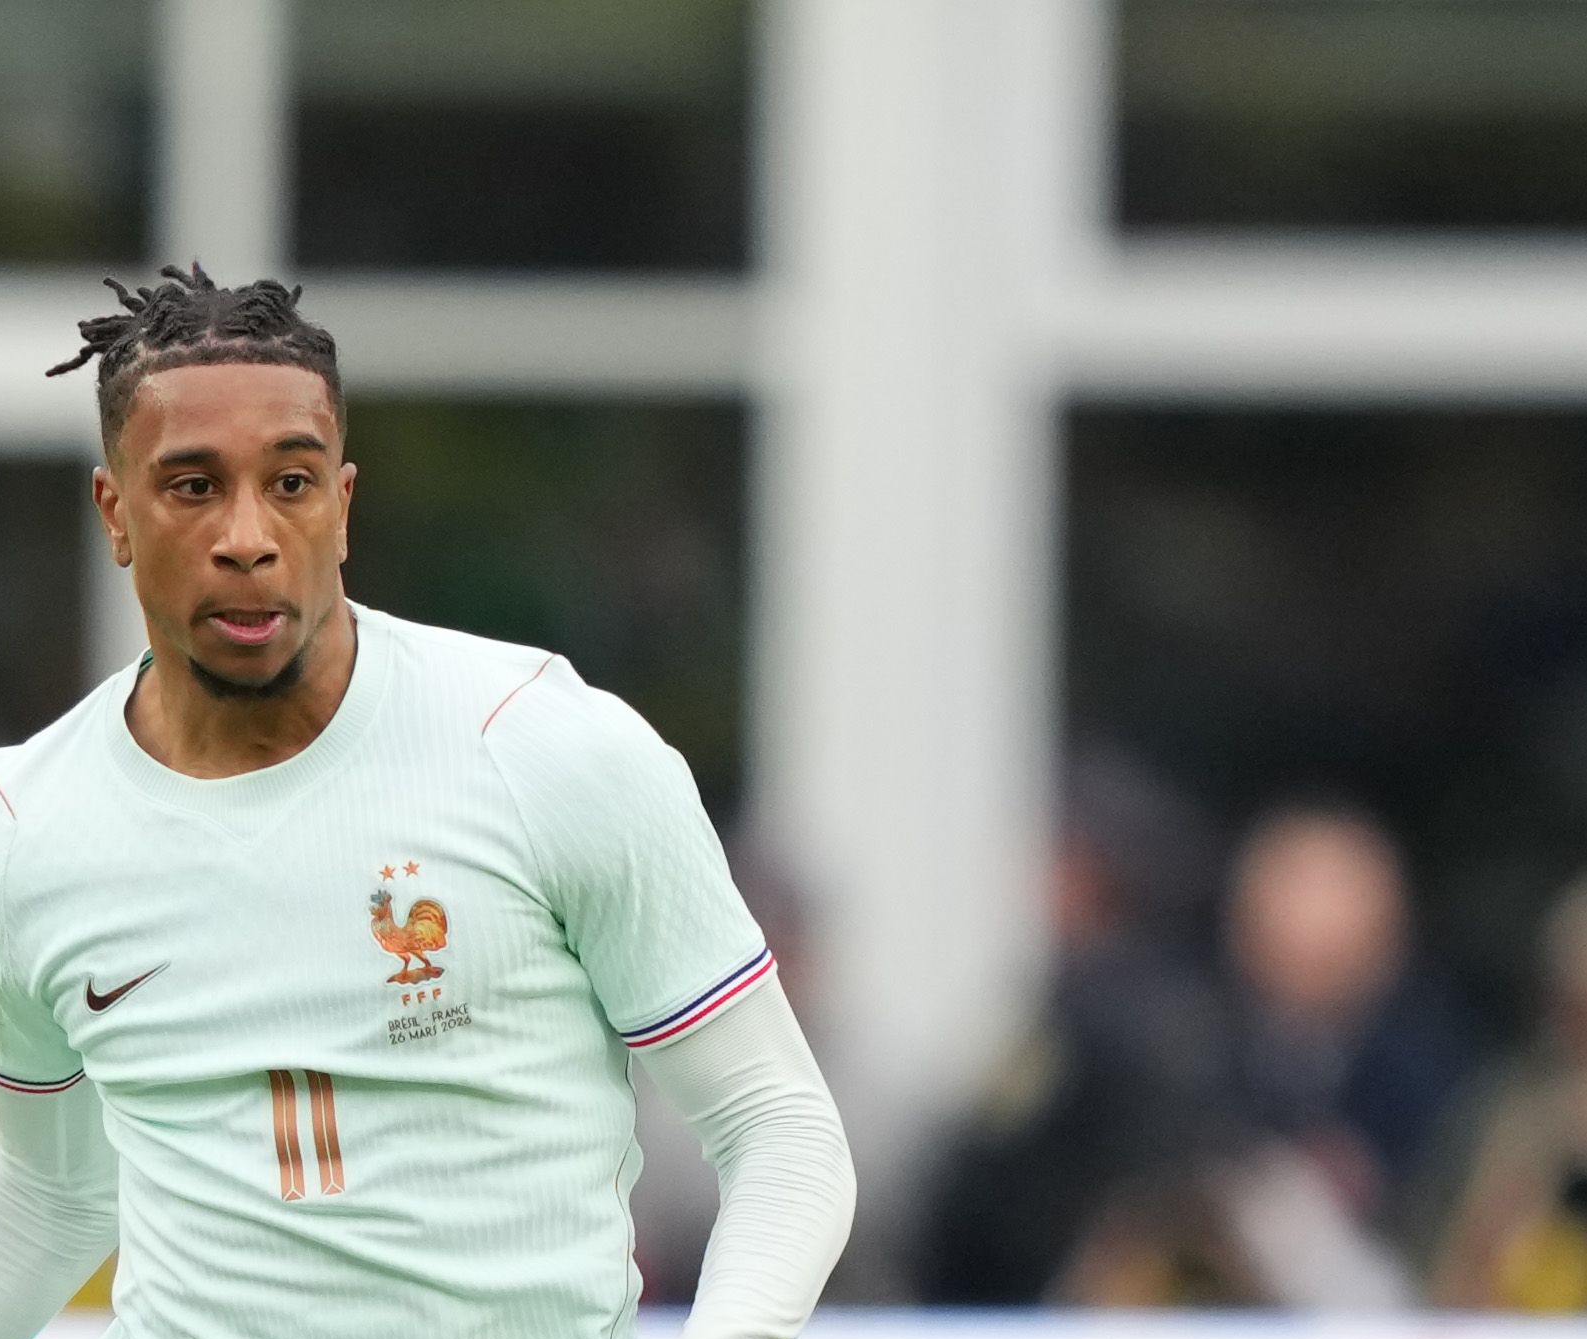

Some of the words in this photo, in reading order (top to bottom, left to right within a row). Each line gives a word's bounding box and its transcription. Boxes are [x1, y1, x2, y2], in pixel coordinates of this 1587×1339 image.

[431, 1003, 469, 1023] FRANCE
[389, 1033, 406, 1045] 26
[409, 1025, 437, 1041] MARS
[441, 1015, 472, 1032] 2026
[265, 1068, 346, 1201] 11
